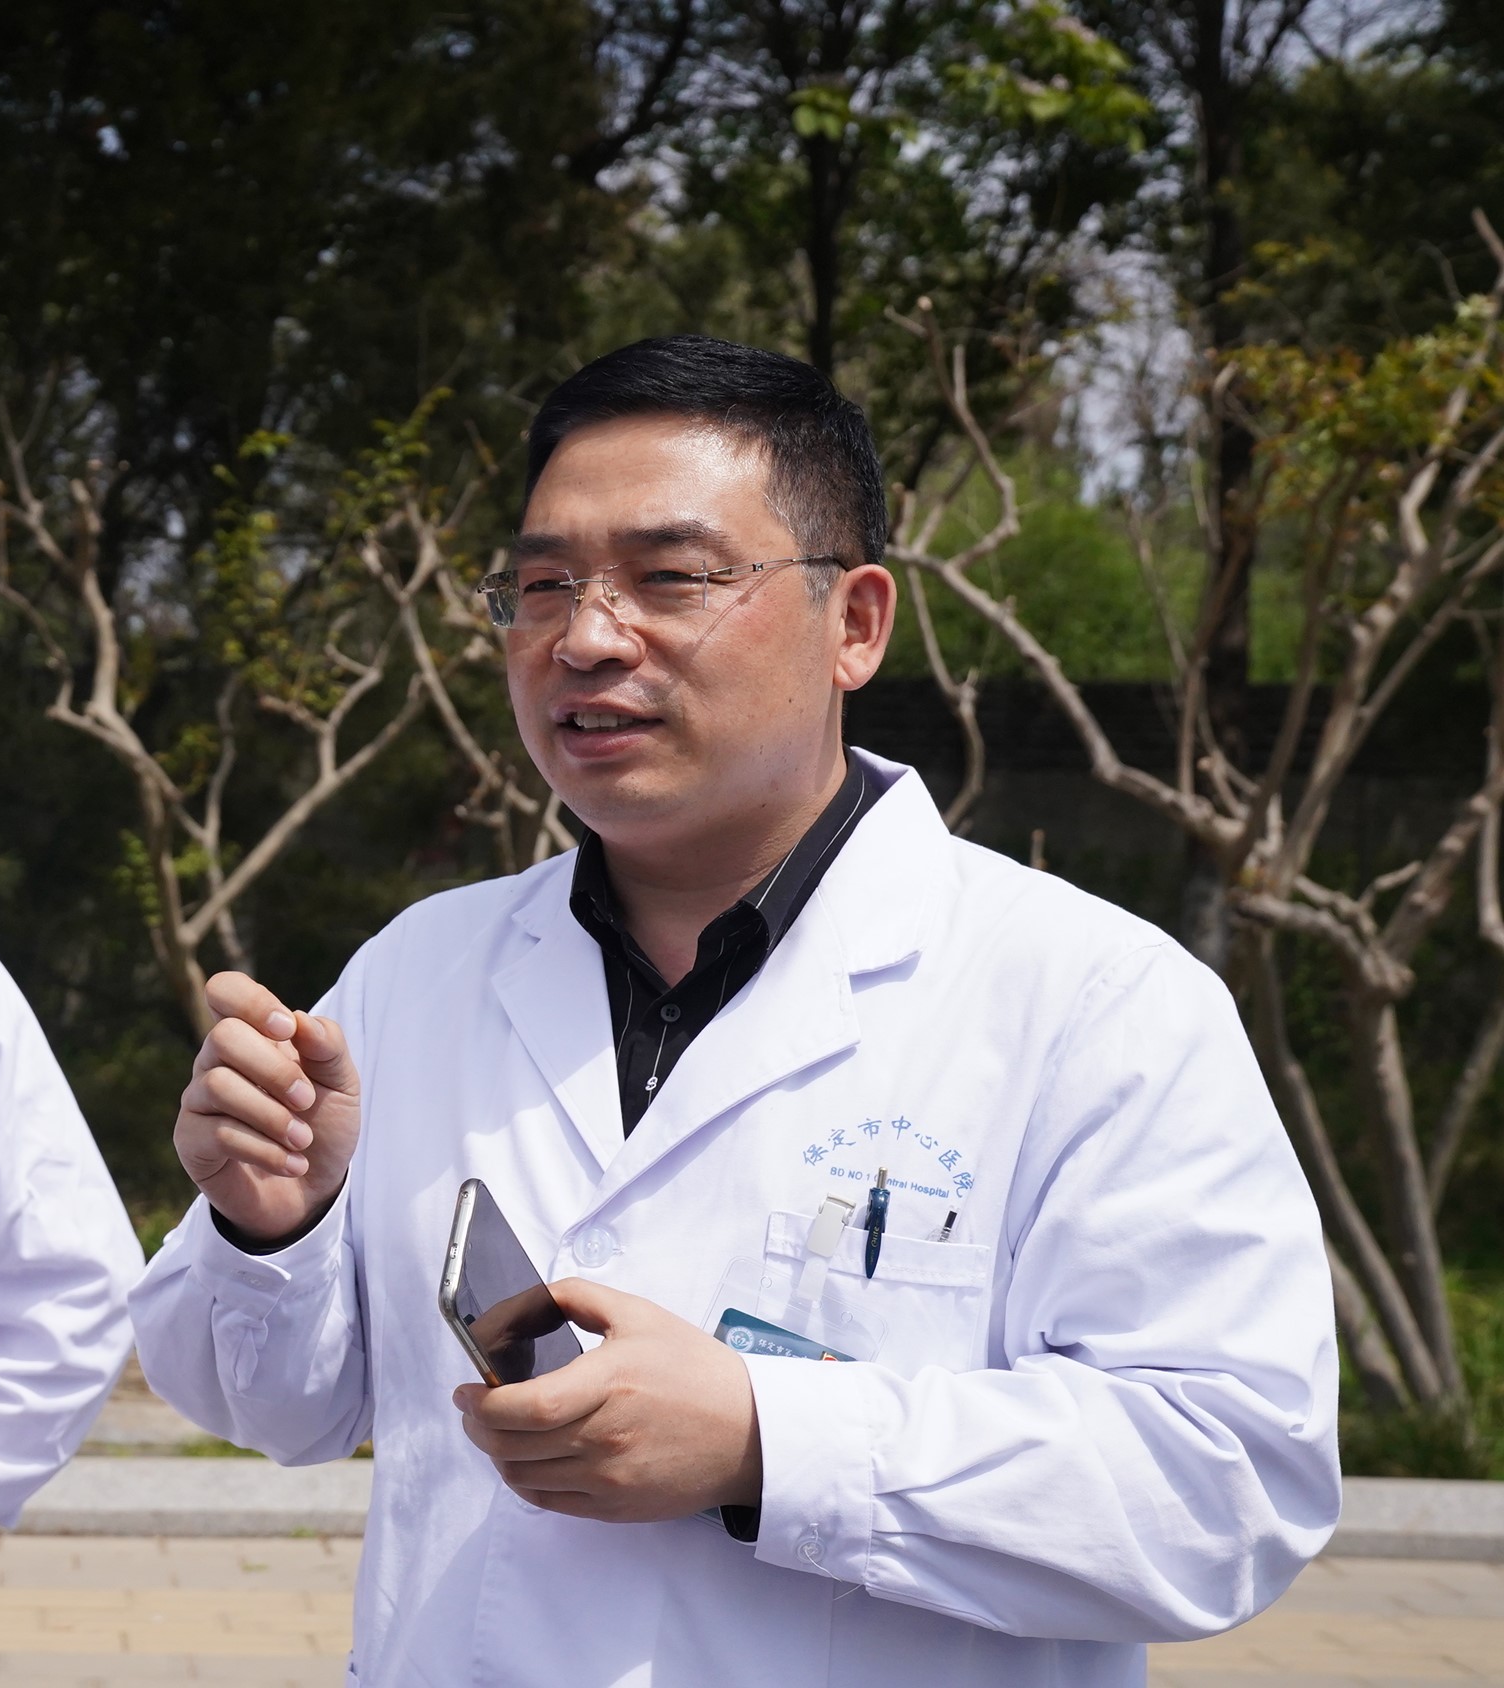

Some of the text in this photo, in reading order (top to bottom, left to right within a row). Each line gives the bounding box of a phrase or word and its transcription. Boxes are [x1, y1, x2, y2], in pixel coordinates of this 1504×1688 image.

[802, 1115, 975, 1199] 保定市中心医院
[830, 1166, 844, 1178] BD
[848, 1169, 863, 1181] NO
[866, 1173, 871, 1182] 1
[910, 1182, 950, 1199] Hospital
